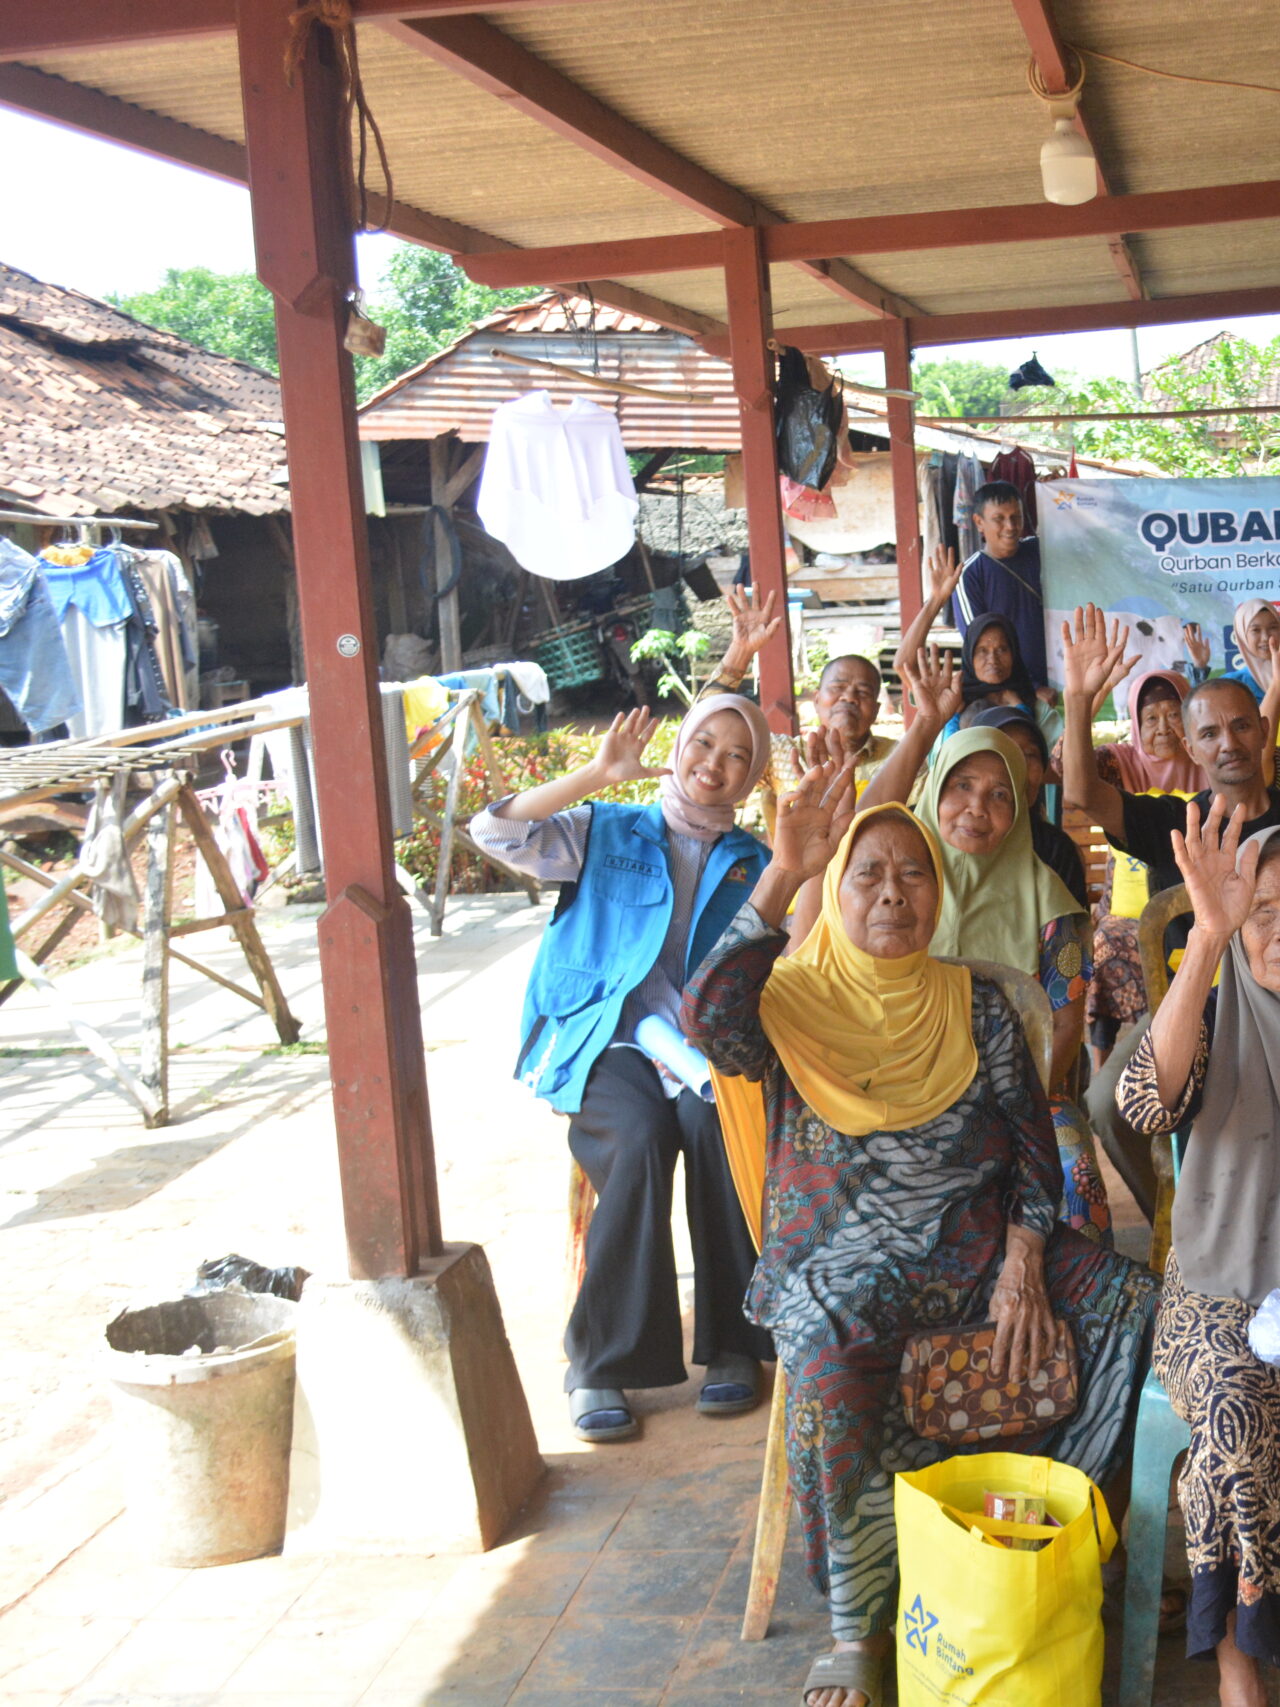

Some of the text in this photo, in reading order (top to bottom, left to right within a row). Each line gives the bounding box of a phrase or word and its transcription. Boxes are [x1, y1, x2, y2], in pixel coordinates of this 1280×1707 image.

[1160, 555, 1231, 574] Qurban
[1217, 578, 1274, 592] Qurban
[937, 1632, 966, 1664] Rumah
